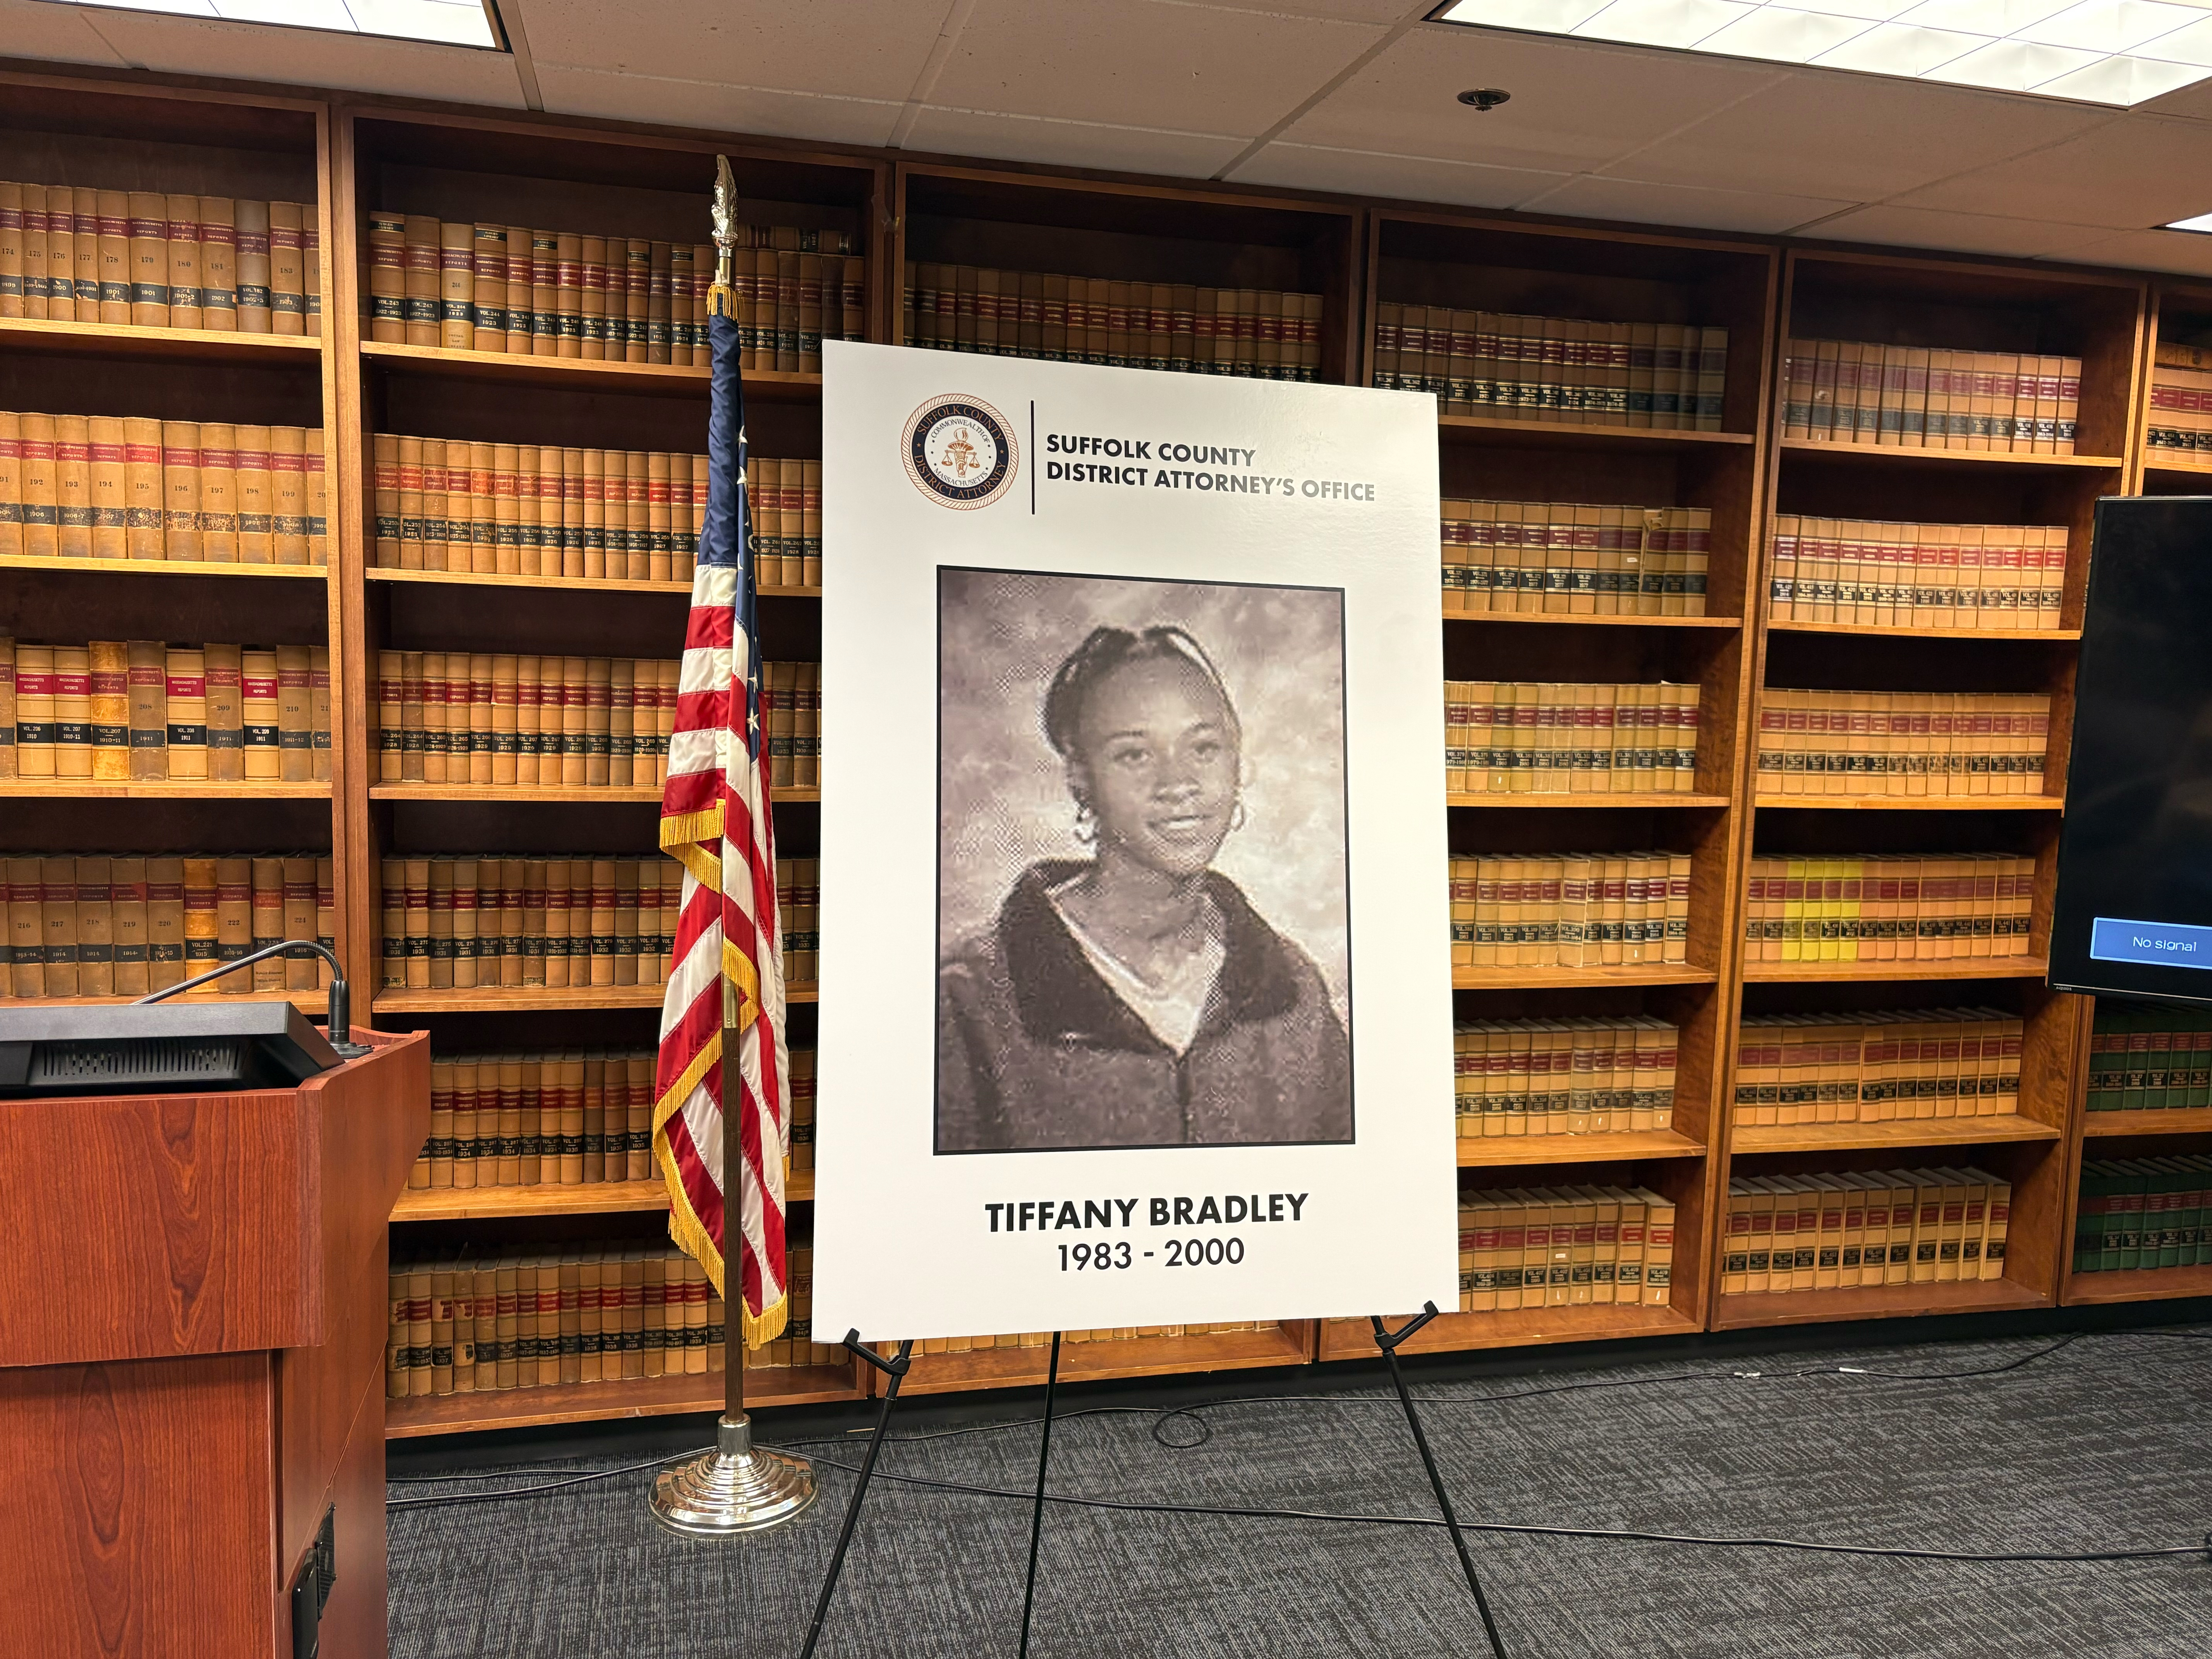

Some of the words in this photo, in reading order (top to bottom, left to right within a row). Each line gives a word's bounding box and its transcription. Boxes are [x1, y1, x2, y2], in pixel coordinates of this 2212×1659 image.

[917, 406, 962, 434] SUFFOLK
[963, 407, 1003, 441] COUNTY
[931, 419, 984, 438] COMMONWEALTH
[1047, 433, 1152, 460] SUFFOLK
[1158, 443, 1255, 467] COUNTY
[914, 455, 955, 496] DISTRICT
[957, 461, 1006, 498] ATTORNEY
[1047, 461, 1146, 487] DISTRICT
[1154, 471, 1294, 497] ATTORNEY'S
[1302, 479, 1375, 501] OFFICE
[2133, 936, 2151, 948] No
[2155, 940, 2196, 952] signal
[985, 1198, 1139, 1232] TIFFANY
[1150, 1193, 1309, 1226] BRADLEY
[1058, 1242, 1132, 1271] 1983
[1164, 1237, 1244, 1266] 2000
